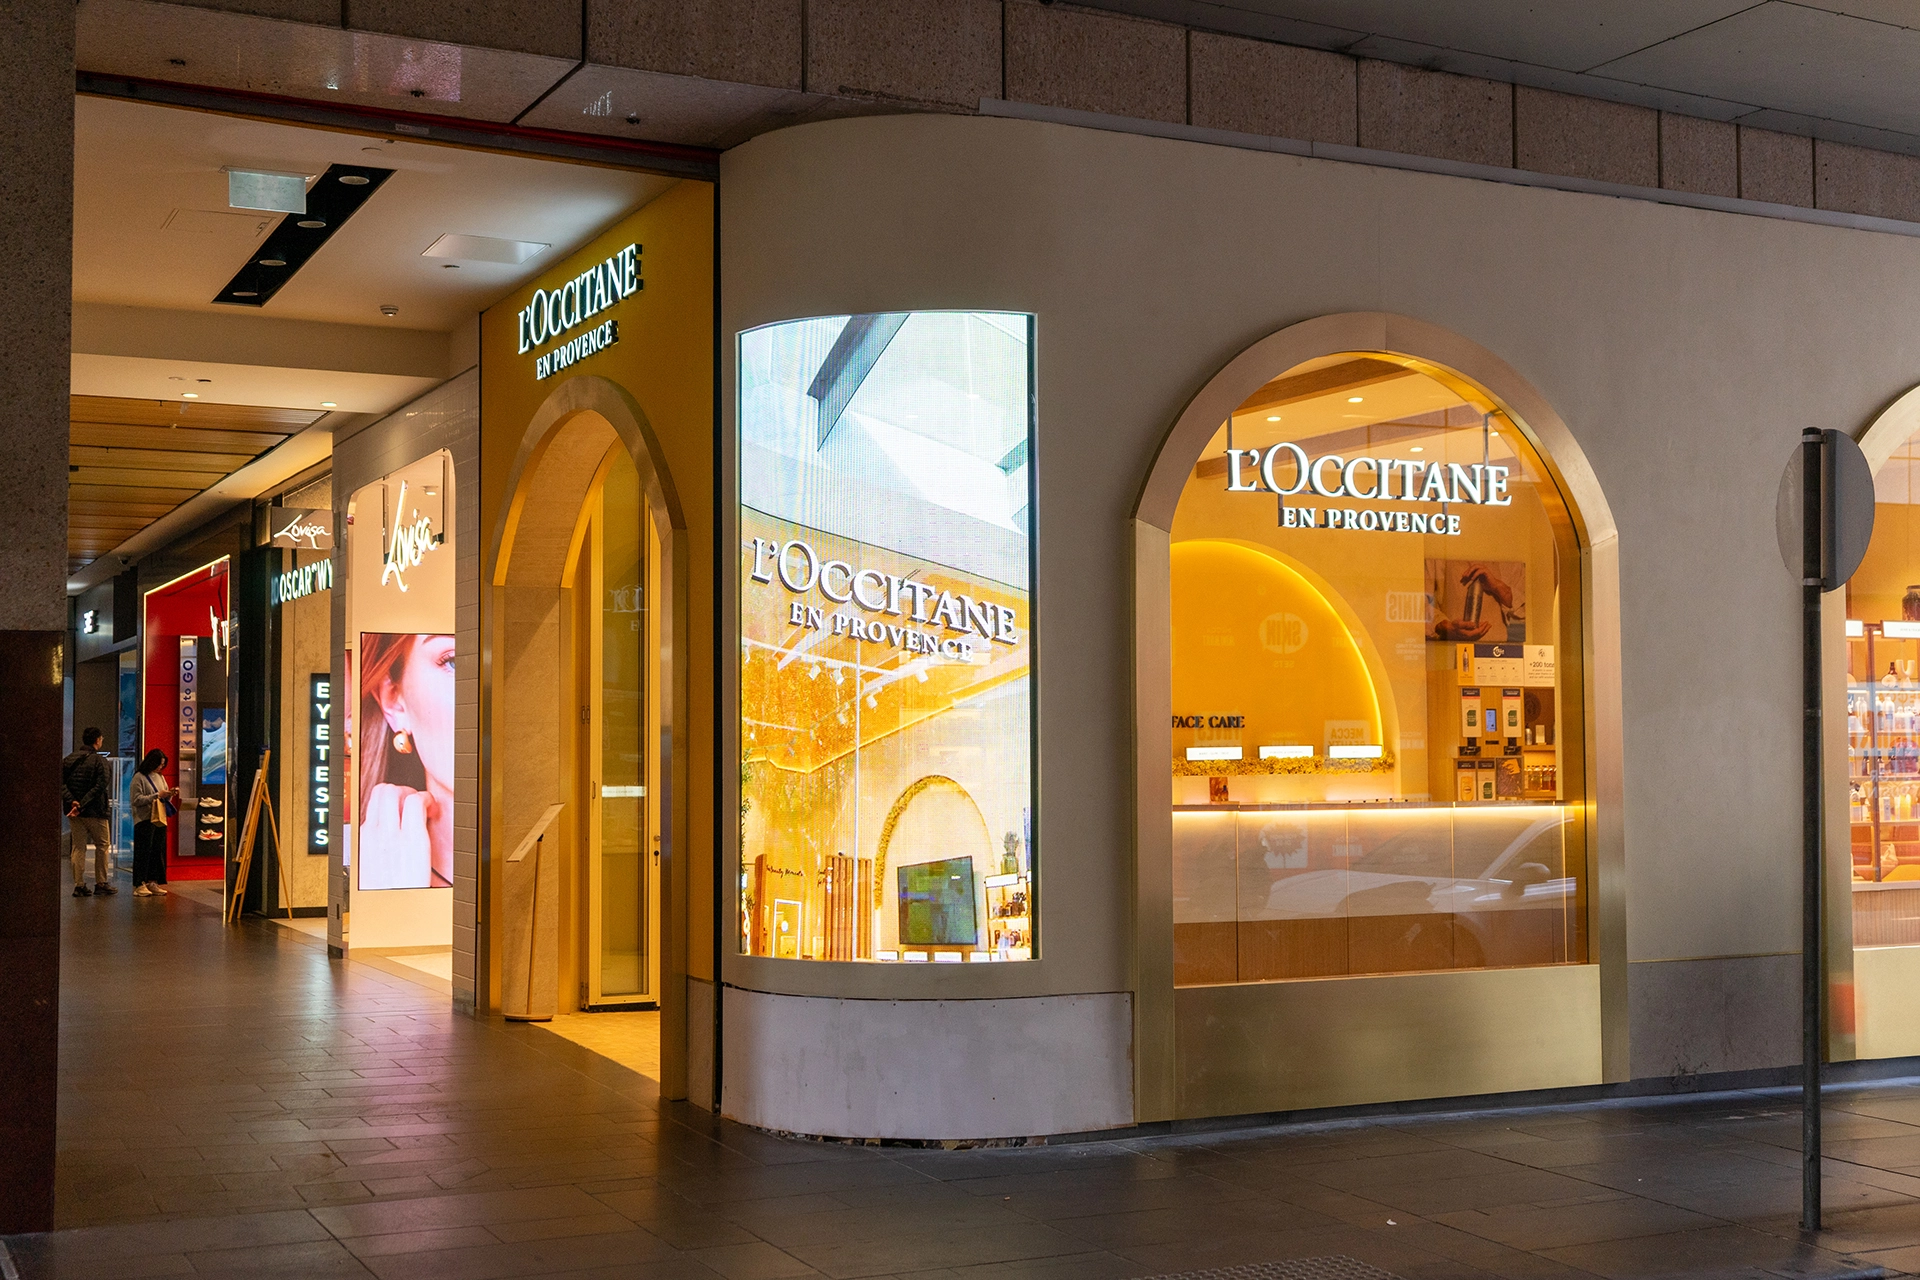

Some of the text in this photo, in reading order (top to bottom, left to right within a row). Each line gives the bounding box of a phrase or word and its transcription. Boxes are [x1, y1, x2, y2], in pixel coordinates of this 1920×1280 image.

[518, 243, 638, 355] L'OCCITANE
[536, 319, 614, 380] EN PROVENCE
[1226, 442, 1512, 506] L'OCCITANE
[273, 514, 332, 550] Lovisa
[382, 480, 439, 592] Lovisa
[1280, 507, 1461, 535] EN PROVENCE
[280, 564, 312, 603] OSCAR
[751, 536, 1019, 645] L'OCCITANE
[789, 602, 975, 663] EN PROVENCE
[182, 660, 194, 683] GO
[183, 688, 191, 701] to
[1171, 715, 1246, 729] FACE CARE
